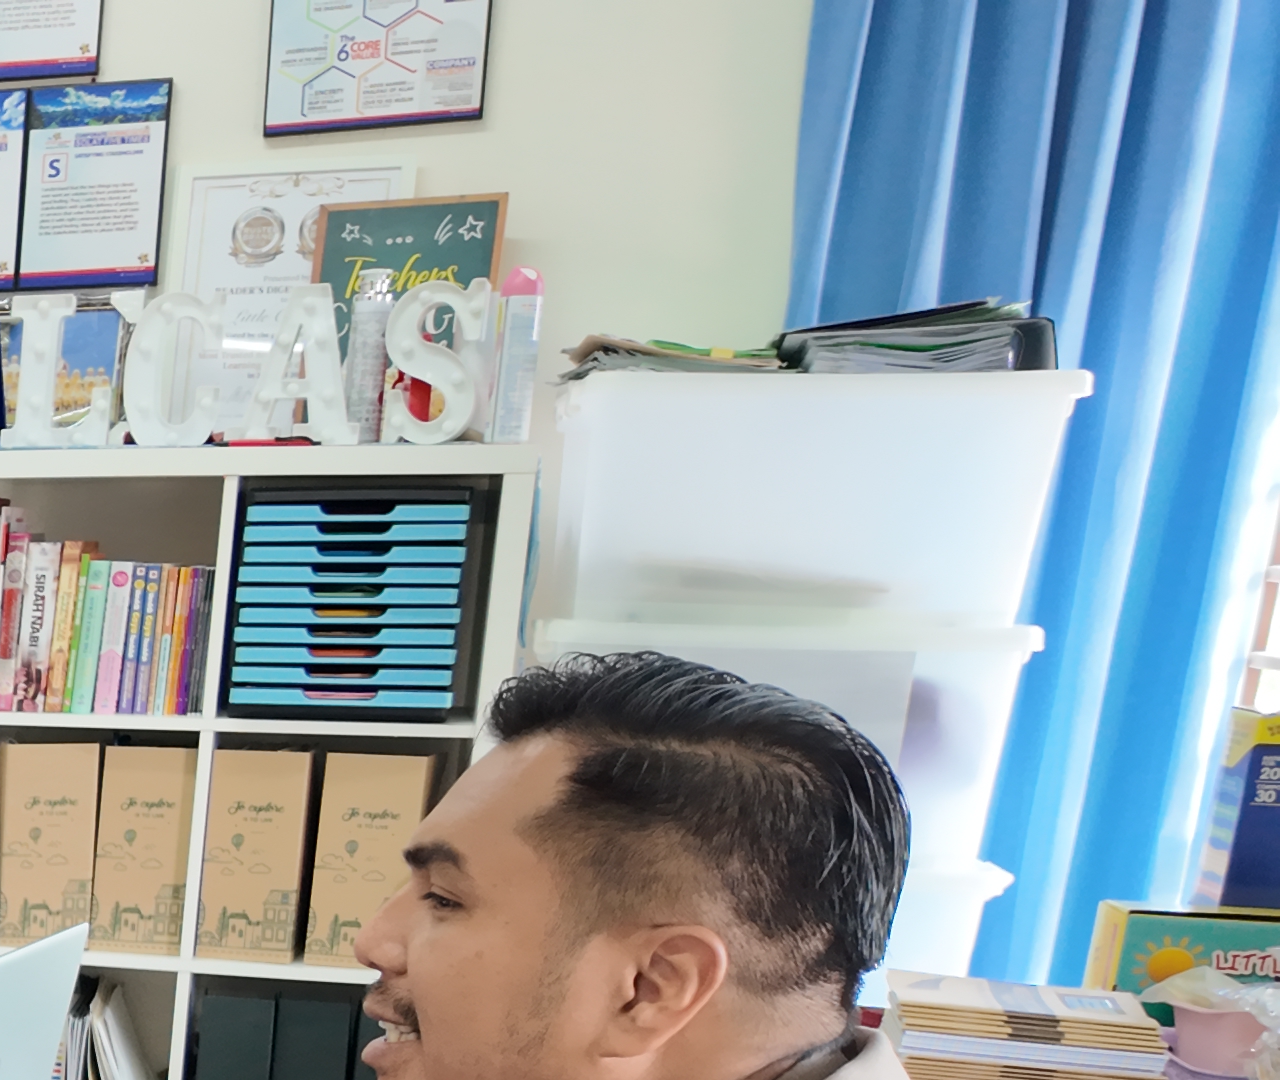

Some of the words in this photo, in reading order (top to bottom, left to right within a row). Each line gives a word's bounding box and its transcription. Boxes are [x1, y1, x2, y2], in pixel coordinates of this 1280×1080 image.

[340, 34, 355, 43] The
[337, 43, 349, 62] 6
[350, 40, 381, 53] CORE
[350, 49, 381, 60] VALUES
[426, 57, 476, 70] COMPANY
[48, 159, 61, 178] S
[343, 253, 465, 299] Techers
[33, 574, 46, 614] SIRAH
[29, 615, 43, 648] NABI
[43, 796, 79, 810] explore
[1254, 789, 1276, 803] 30
[140, 798, 176, 811] explore
[248, 802, 284, 815] explore
[363, 809, 400, 823] explore
